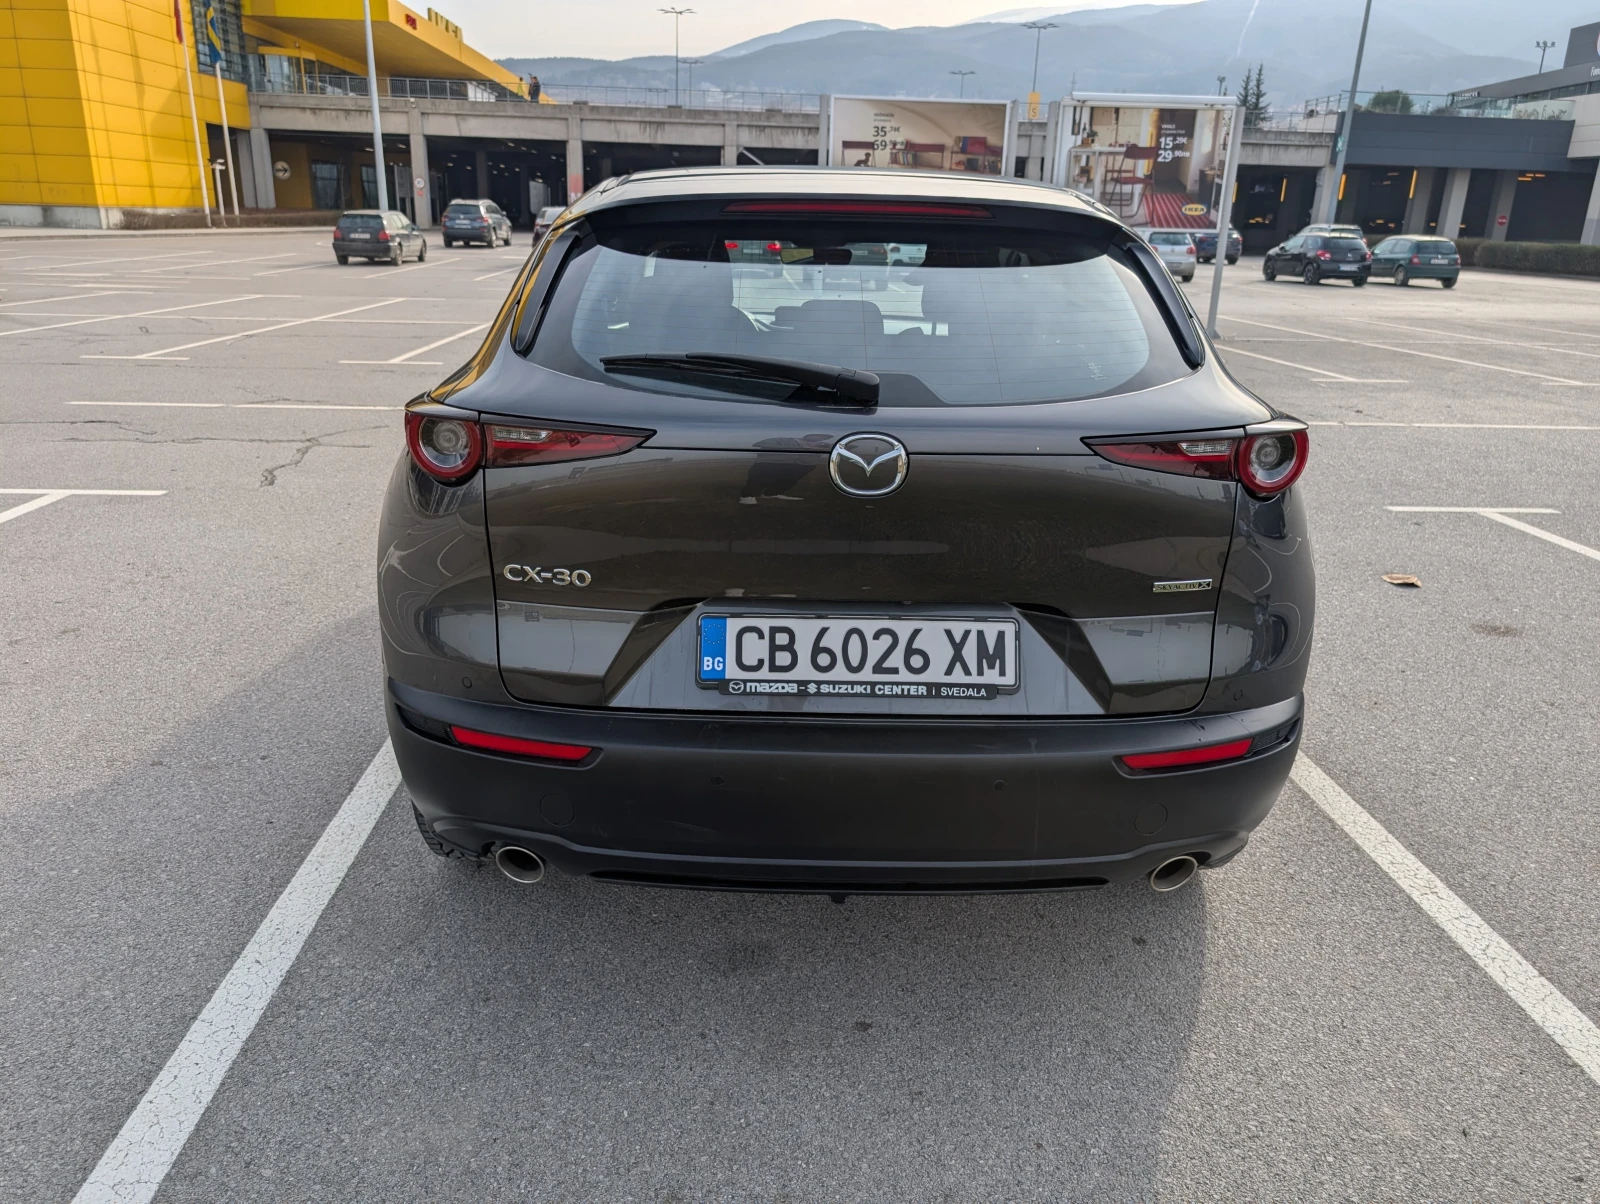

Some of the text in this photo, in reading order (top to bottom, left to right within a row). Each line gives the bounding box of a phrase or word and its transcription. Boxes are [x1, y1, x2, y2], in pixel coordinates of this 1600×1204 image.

[503, 564, 592, 587] CX-30
[735, 625, 1006, 677] CB 6026 XM
[703, 656, 723, 671] BG
[819, 683, 871, 694] SUZUKI
[875, 684, 927, 696] CENTER
[940, 687, 987, 697] SVEDALA
